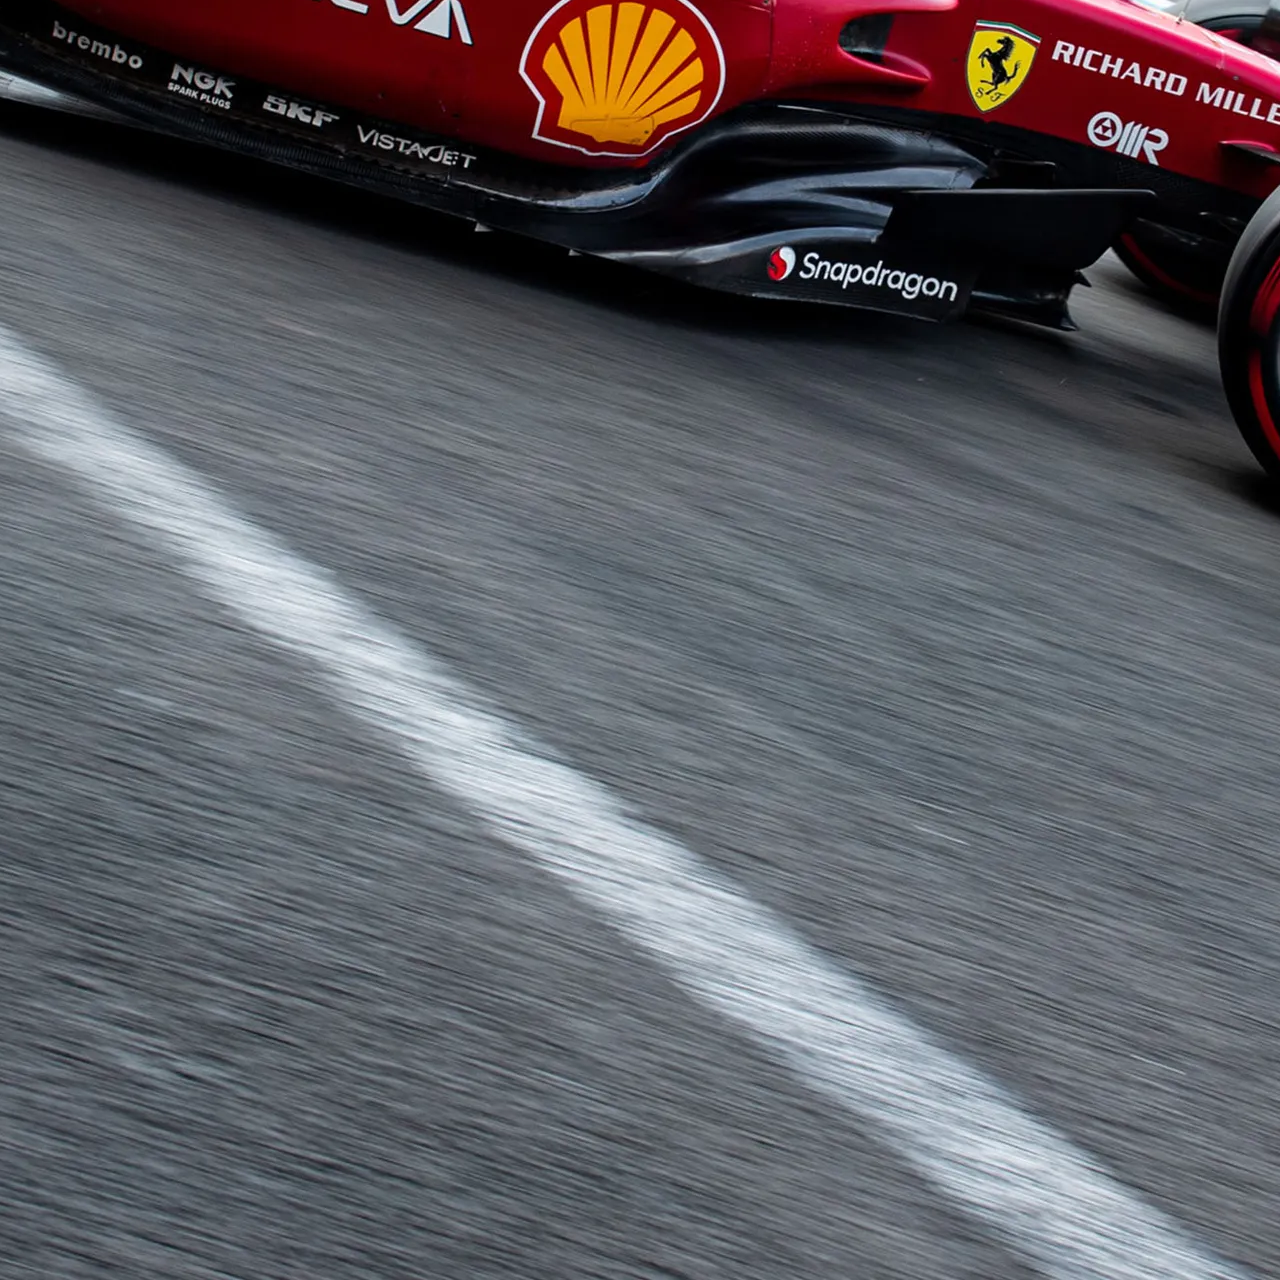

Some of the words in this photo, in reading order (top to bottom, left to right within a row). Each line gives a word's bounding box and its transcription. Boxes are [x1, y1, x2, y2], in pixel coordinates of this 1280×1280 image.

[52, 20, 144, 69] brembo
[170, 63, 237, 100] NGK
[1051, 40, 1187, 97] RICHARD
[167, 82, 198, 100] SPARK
[199, 93, 232, 110] PLUGS
[262, 94, 340, 128] SKF
[799, 252, 958, 302] Snapdragon
